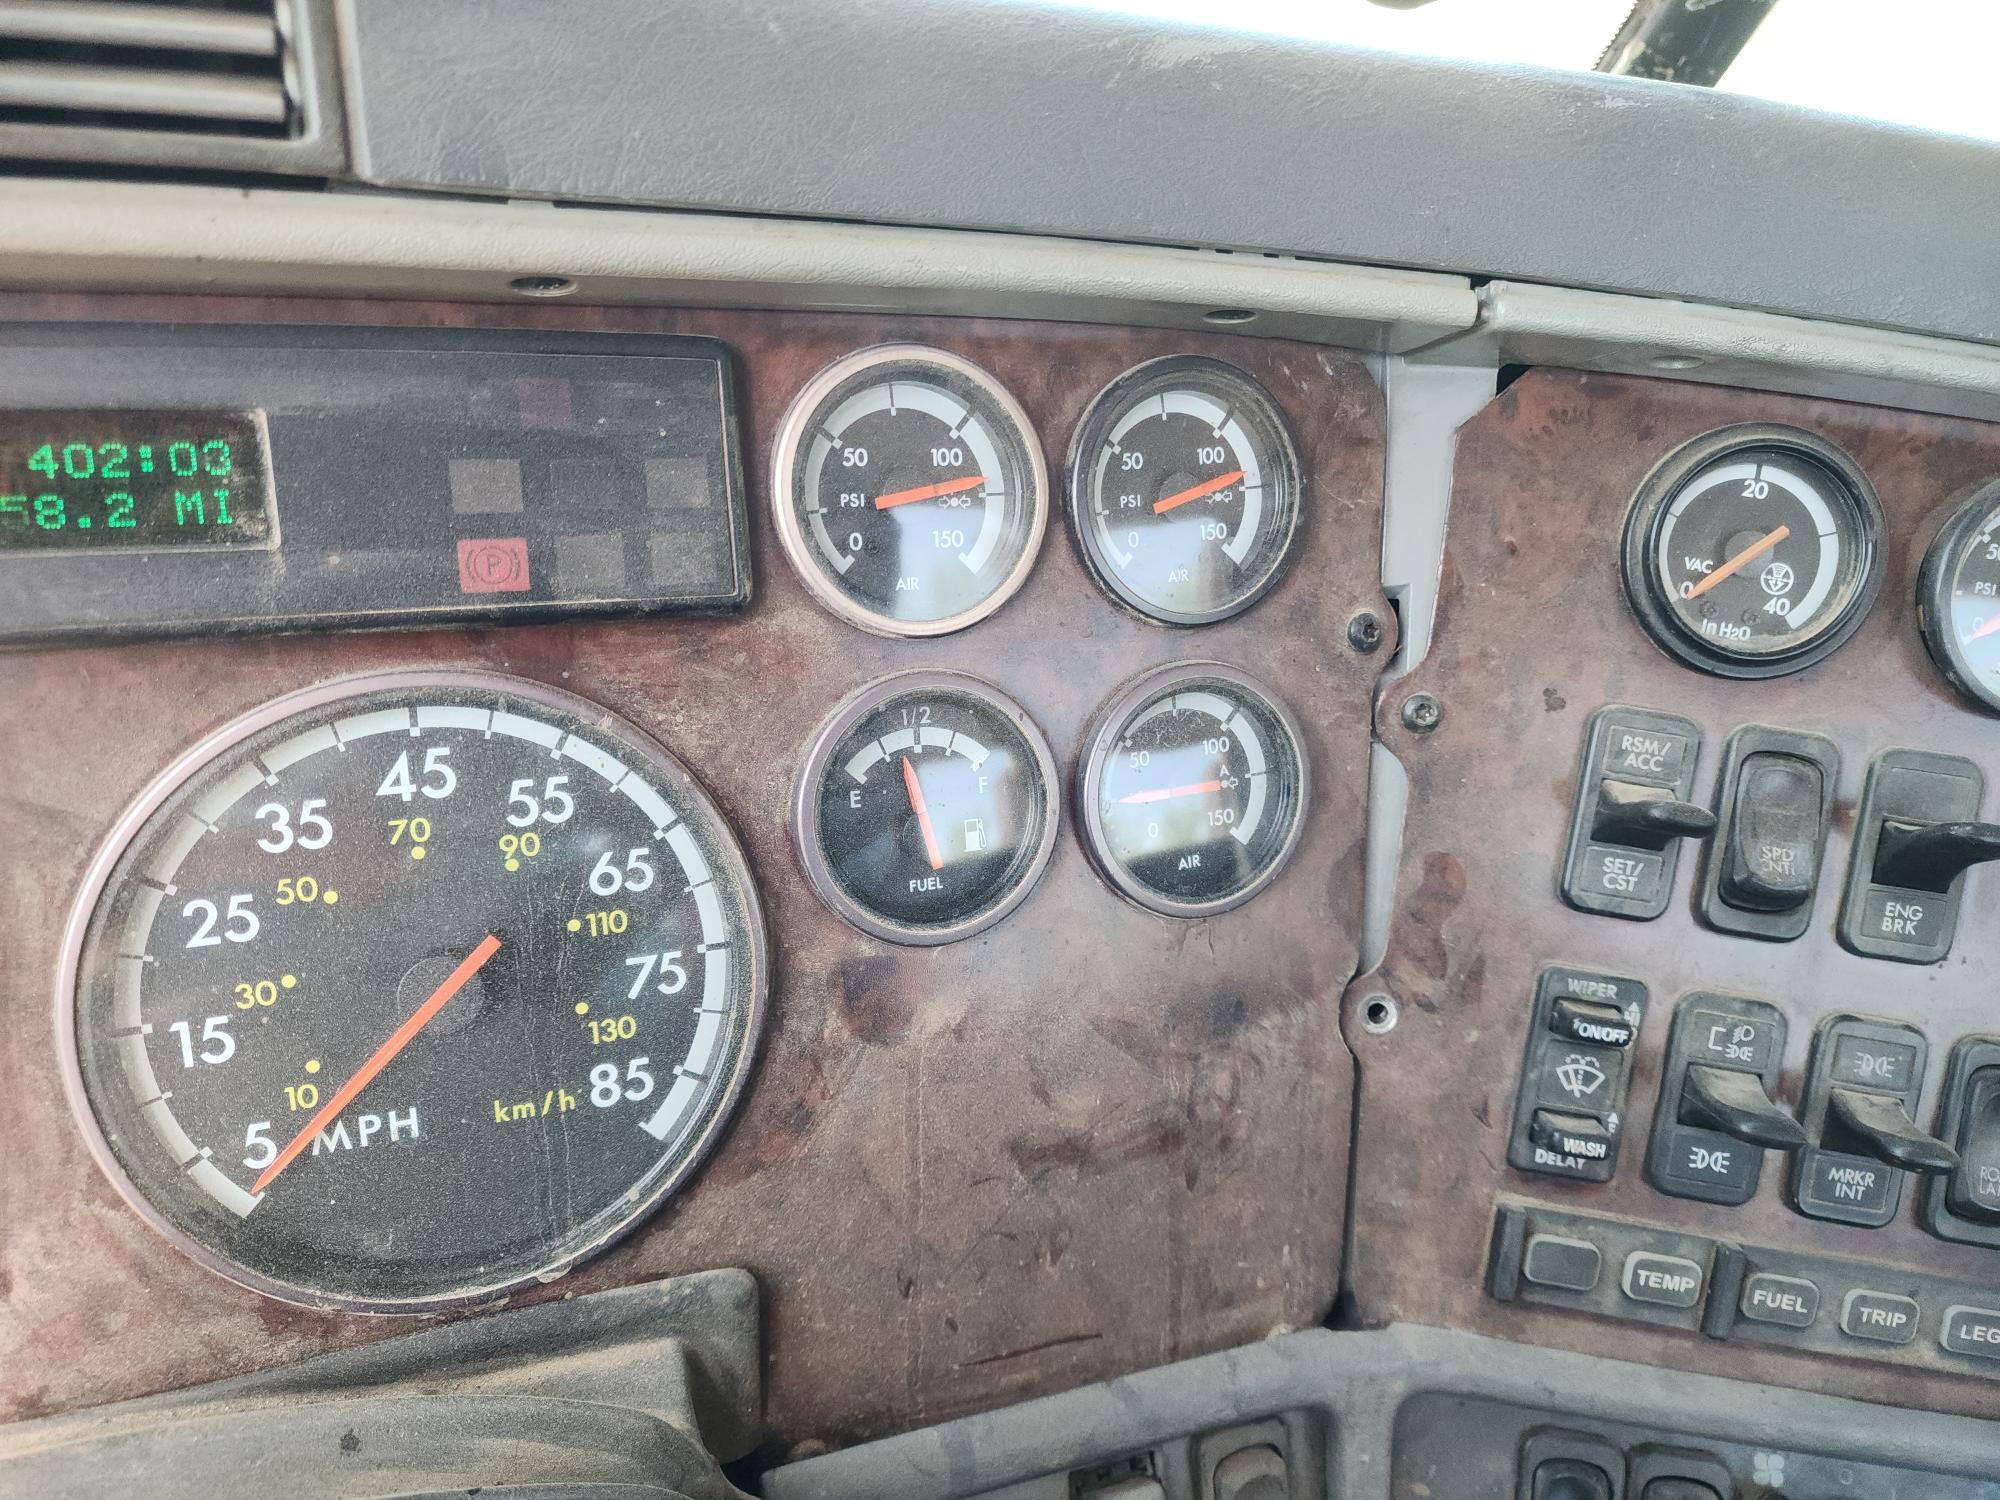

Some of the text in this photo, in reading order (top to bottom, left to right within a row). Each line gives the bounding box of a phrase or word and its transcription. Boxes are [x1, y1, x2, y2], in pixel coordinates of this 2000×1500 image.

[28, 439, 231, 479] 402:03
[842, 448, 868, 466] 50
[930, 448, 962, 466] 100
[1121, 452, 1143, 470] 50
[1197, 446, 1225, 465] 100
[1741, 479, 1768, 499] 20
[175, 489, 233, 525] MI
[840, 494, 865, 507] PSI
[1120, 495, 1141, 508] PSI
[932, 531, 964, 548] 150
[1128, 532, 1139, 548] 0
[1200, 523, 1227, 540] 150
[849, 533, 863, 550] 0
[487, 554, 503, 577] P
[1685, 556, 1713, 574] VAC
[896, 577, 919, 591] AIR
[1168, 568, 1189, 583] AIR
[1680, 581, 1694, 599] 0
[1975, 582, 1997, 597] PSI
[1763, 597, 1790, 616] 40
[901, 706, 931, 726] 1/2
[1202, 736, 1230, 755] 100
[1621, 735, 1671, 756] RSM/
[1129, 751, 1150, 769] 50
[1624, 753, 1664, 772] ACC
[375, 747, 457, 801] 45
[1220, 765, 1229, 777] A
[978, 776, 988, 793] F
[505, 776, 574, 827] 55
[850, 790, 861, 808] E
[255, 799, 333, 854] 35
[1207, 808, 1234, 826] 150
[387, 817, 431, 846] 70
[1147, 822, 1158, 839] 0
[499, 832, 540, 860] 90
[1761, 845, 1794, 861] SPD
[588, 848, 654, 896] 65
[1178, 857, 1201, 871] AIR
[1602, 857, 1644, 876] SET/
[275, 876, 318, 905] 50
[909, 876, 944, 892] FUEL
[1602, 873, 1638, 892] CST
[1885, 902, 1923, 921] ENG
[183, 894, 260, 949] 25
[586, 909, 628, 937] 110
[1881, 918, 1918, 935] BRK
[625, 950, 687, 999] 75
[234, 980, 277, 1009] 30
[1567, 978, 1618, 999] WIPER
[588, 1015, 636, 1045] 130
[168, 1015, 236, 1068] 15
[589, 1057, 655, 1108] 85
[283, 1083, 319, 1111] 10
[494, 1089, 576, 1123] km/h
[312, 1107, 419, 1155] MPH
[242, 1121, 278, 1169] 5
[1563, 1138, 1607, 1159] WASH
[1535, 1148, 1586, 1170] DELAY
[1828, 1167, 1875, 1187] MRKR
[1834, 1183, 1867, 1201] INT
[1637, 1269, 1695, 1293] TEMP
[1752, 1290, 1808, 1313] FUEL
[1859, 1307, 1907, 1328] TRIP
[1960, 1324, 2000, 1344] LEG
